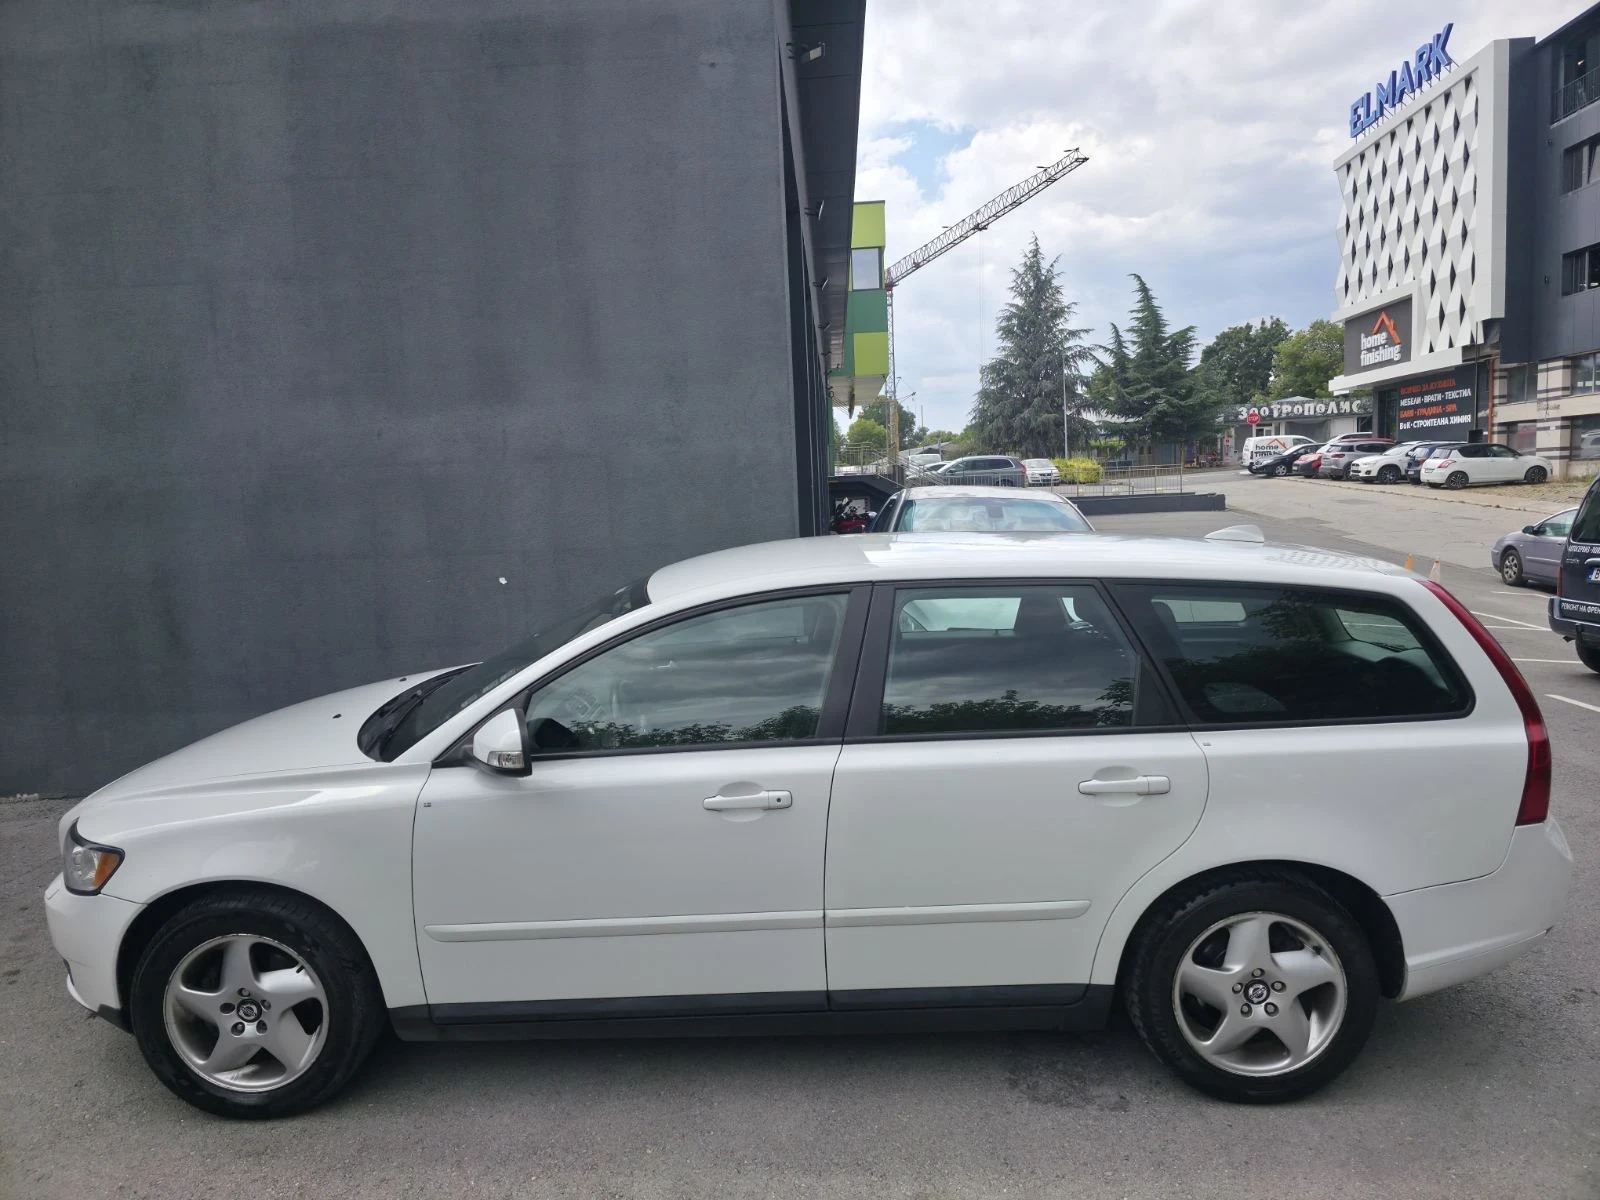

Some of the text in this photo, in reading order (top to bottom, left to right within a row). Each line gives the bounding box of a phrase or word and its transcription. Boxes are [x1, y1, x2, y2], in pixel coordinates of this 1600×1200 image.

[1349, 23, 1454, 138] ELMARK
[1361, 332, 1387, 350] home
[1360, 345, 1402, 366] finishing
[1400, 388, 1472, 407] МЕБЕЛИ ВРАТИ ТЕКСТИЛ
[1413, 416, 1449, 428] СТРОИТЕЛНА
[1450, 414, 1472, 424] ХИМИЯ
[1561, 602, 1579, 610] РЕМОНТ
